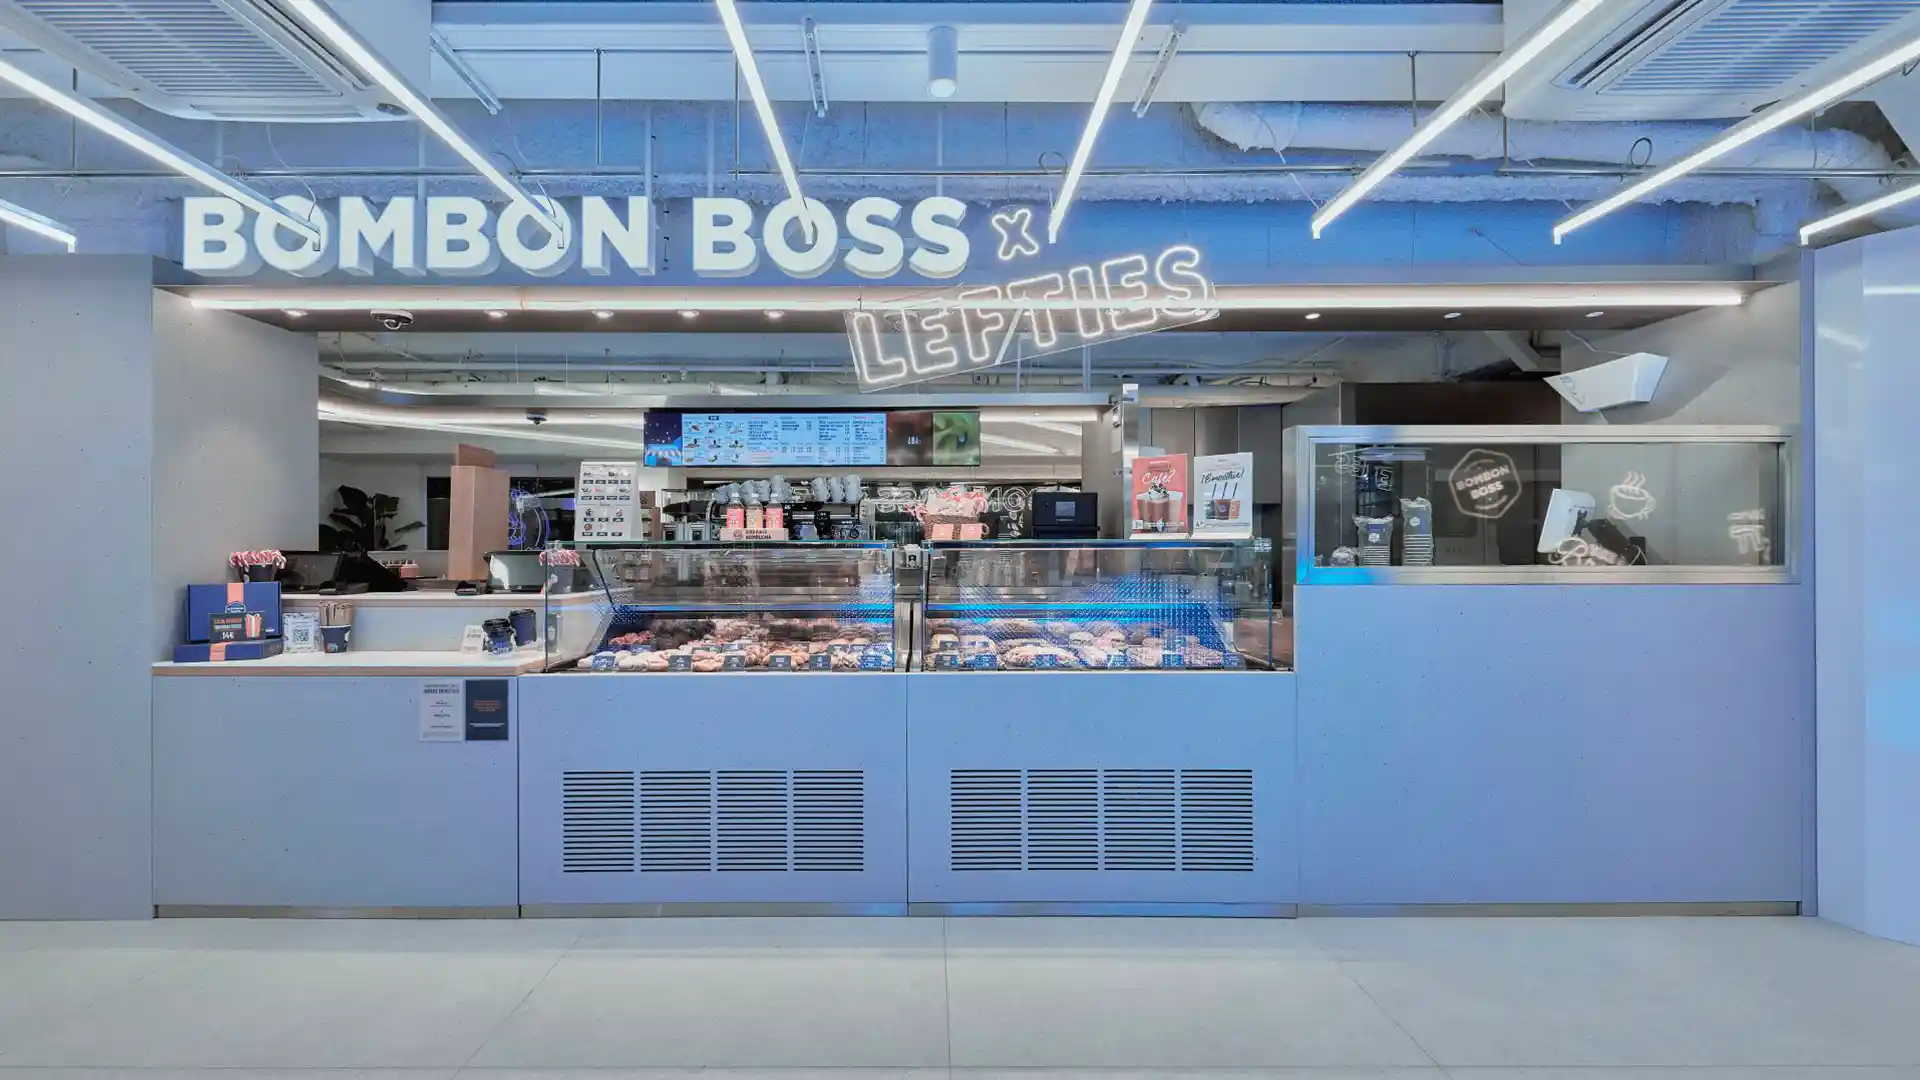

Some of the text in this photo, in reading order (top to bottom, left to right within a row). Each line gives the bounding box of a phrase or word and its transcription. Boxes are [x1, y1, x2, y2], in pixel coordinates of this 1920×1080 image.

[183, 195, 652, 274] BOMBON
[692, 195, 970, 275] BOSS
[852, 245, 1209, 384] LEFTIES
[1455, 464, 1511, 491] BOMBON
[1470, 480, 1504, 499] BOSS
